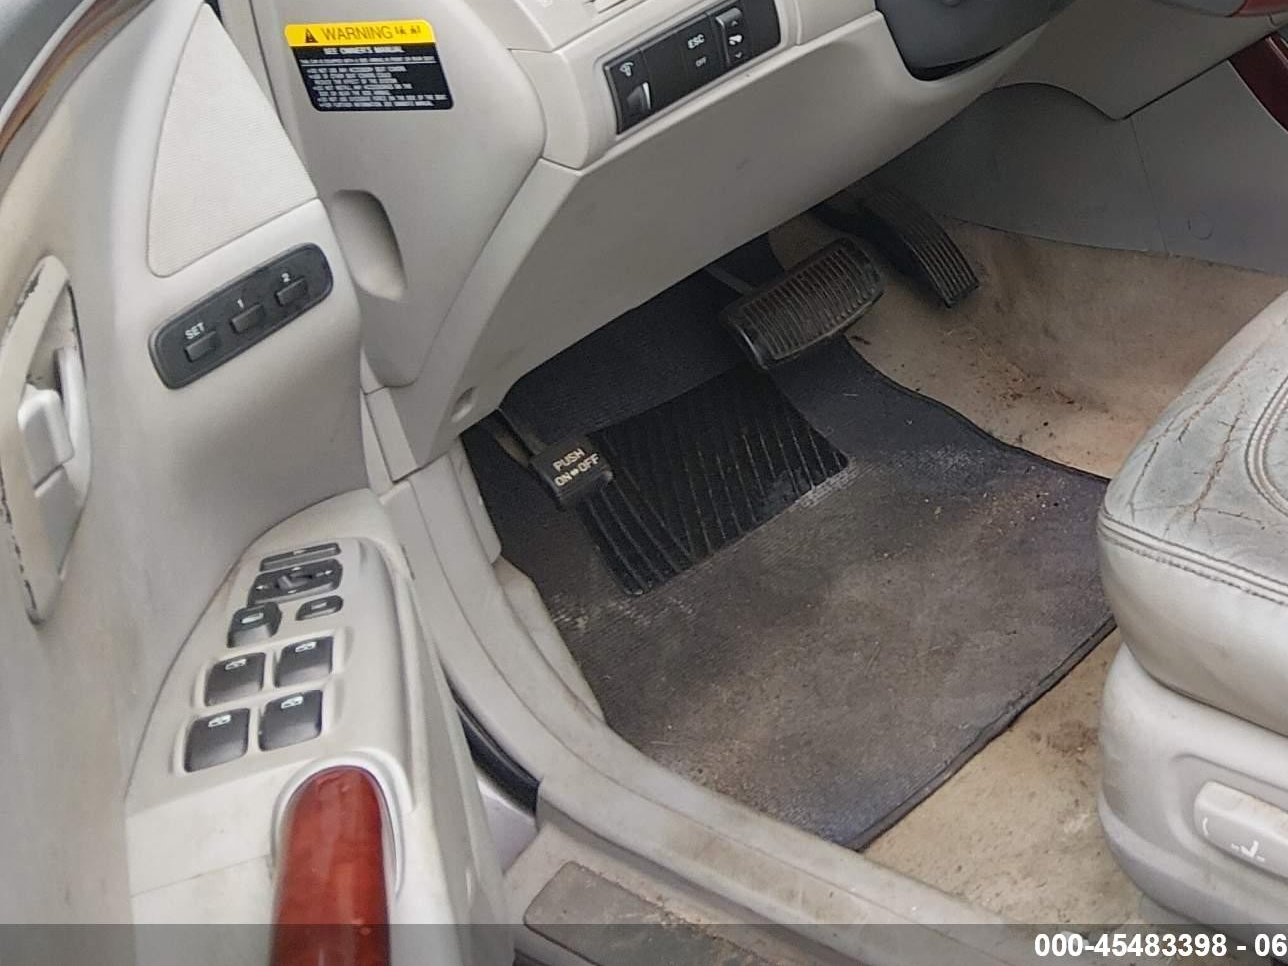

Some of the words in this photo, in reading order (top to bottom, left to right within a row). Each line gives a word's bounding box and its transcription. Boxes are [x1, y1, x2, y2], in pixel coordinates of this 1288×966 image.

[320, 25, 394, 42] WARNING
[687, 34, 705, 49] ESC
[695, 57, 708, 68] OFF
[282, 273, 290, 283] 2
[237, 299, 244, 309] 1
[185, 322, 205, 339] SET
[553, 448, 585, 472] PUSH
[554, 472, 573, 486] ON
[578, 453, 599, 472] OFF
